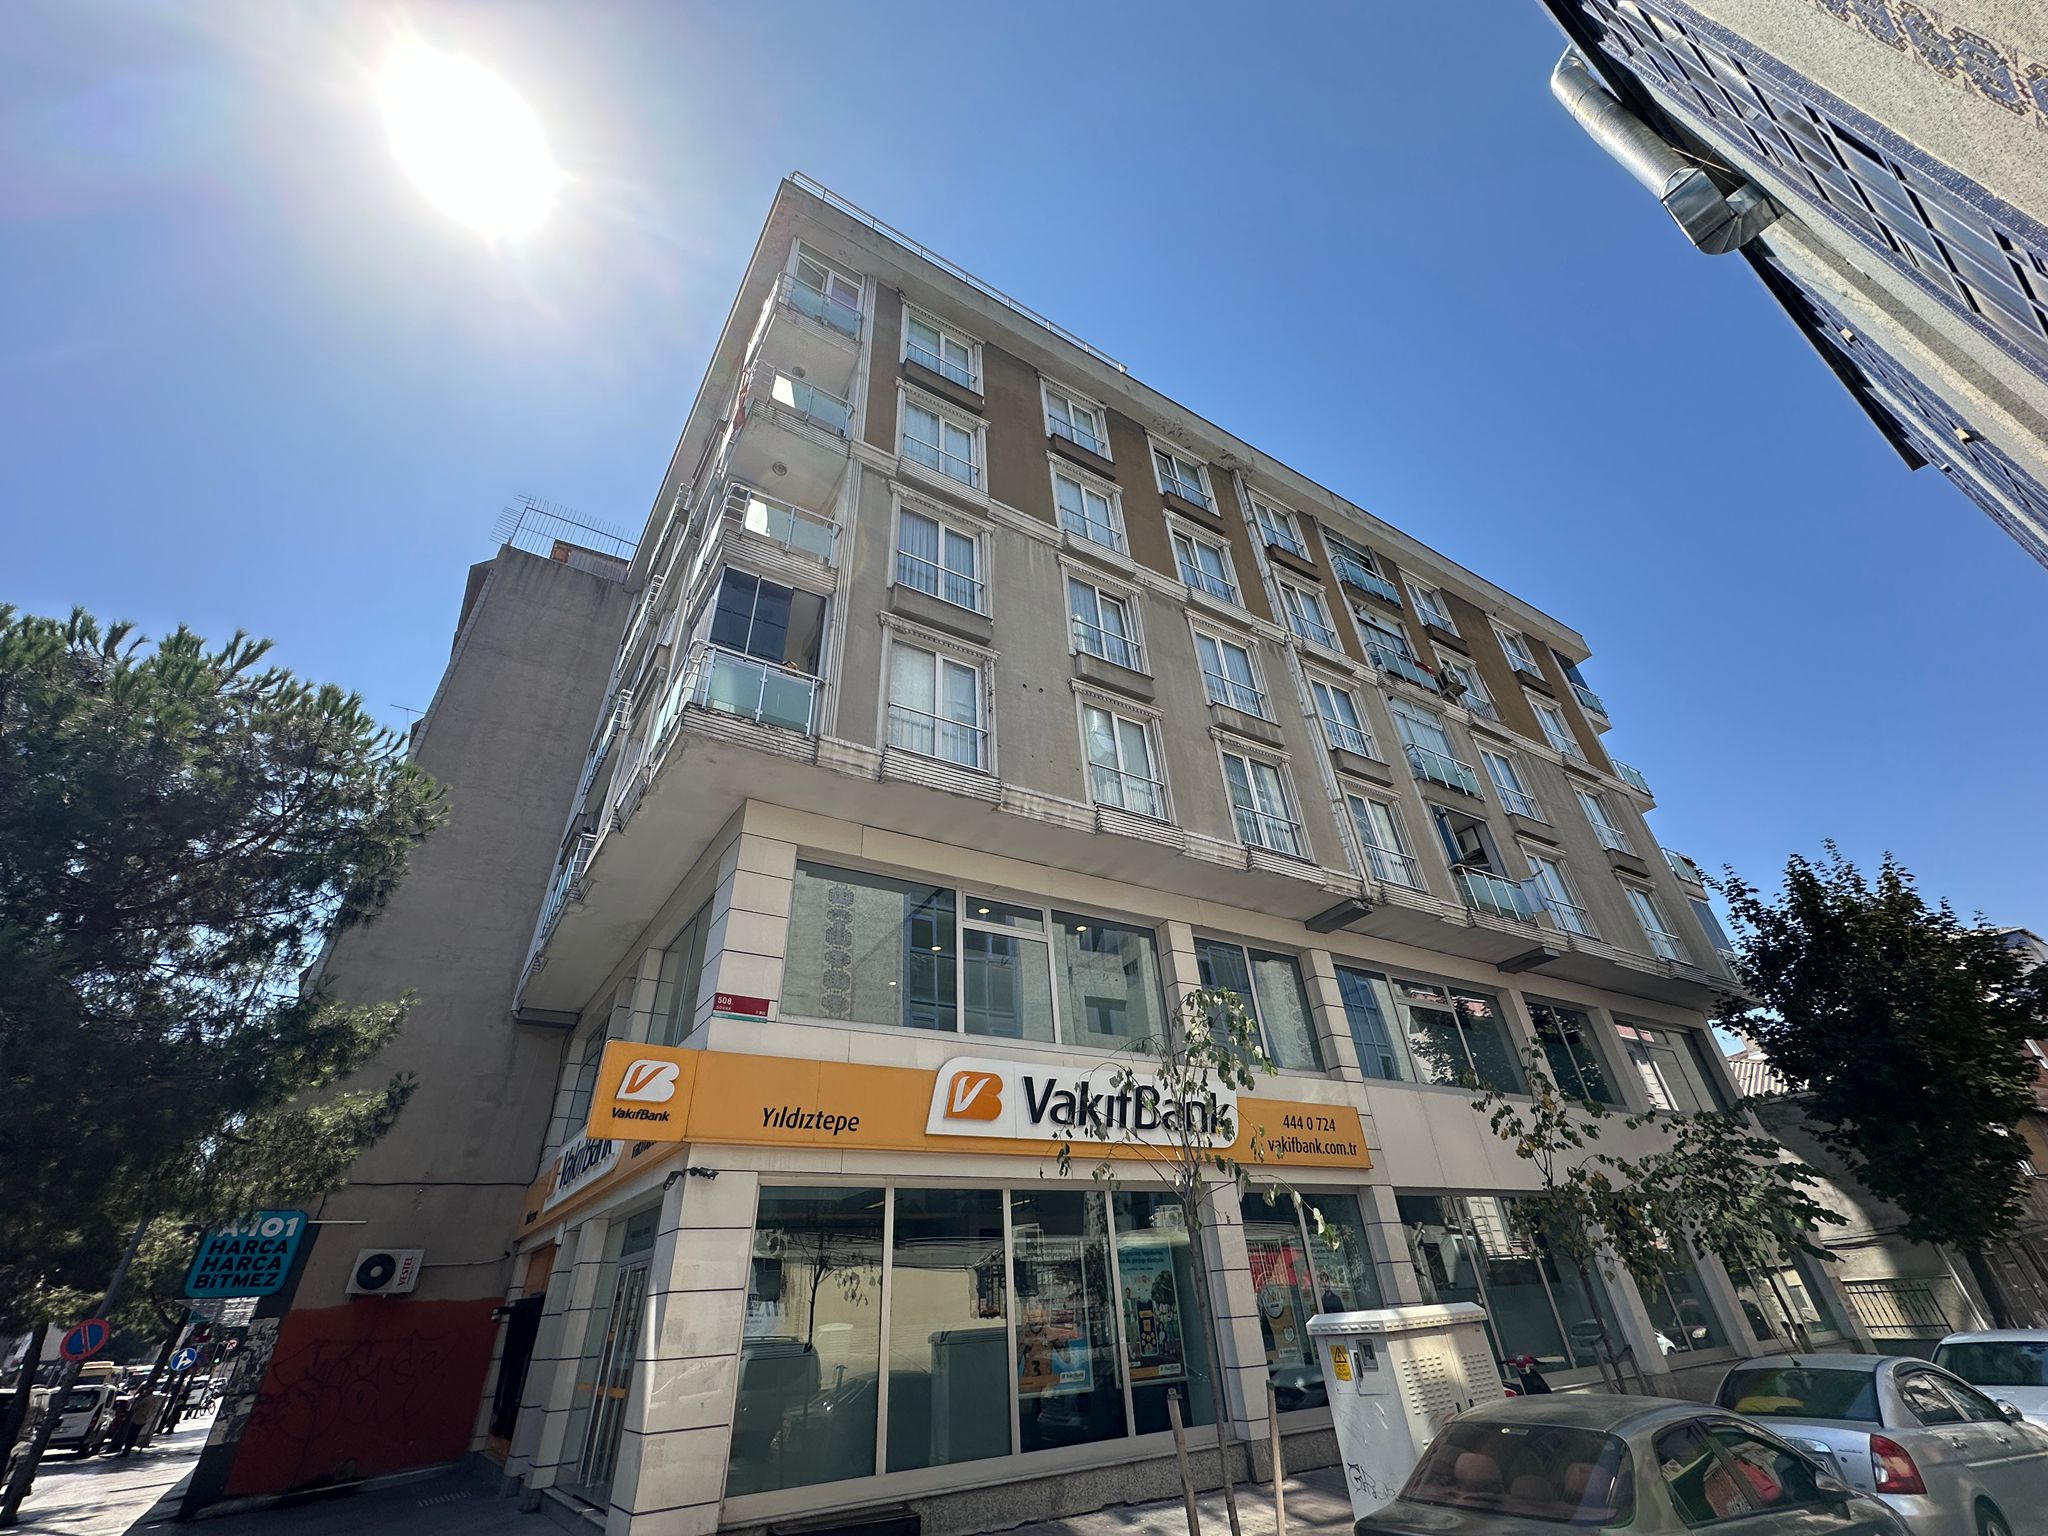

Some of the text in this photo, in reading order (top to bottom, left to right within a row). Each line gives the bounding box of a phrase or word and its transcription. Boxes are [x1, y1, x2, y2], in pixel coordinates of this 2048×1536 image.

[762, 1106, 860, 1136] Yıldıztepe
[1283, 1115, 1335, 1132] 444 0 724
[1267, 1136, 1357, 1156] vakifbank.com.tr
[208, 1240, 288, 1255] HARCA
[200, 1256, 281, 1272] HARCA
[397, 1256, 414, 1286] VESTEL
